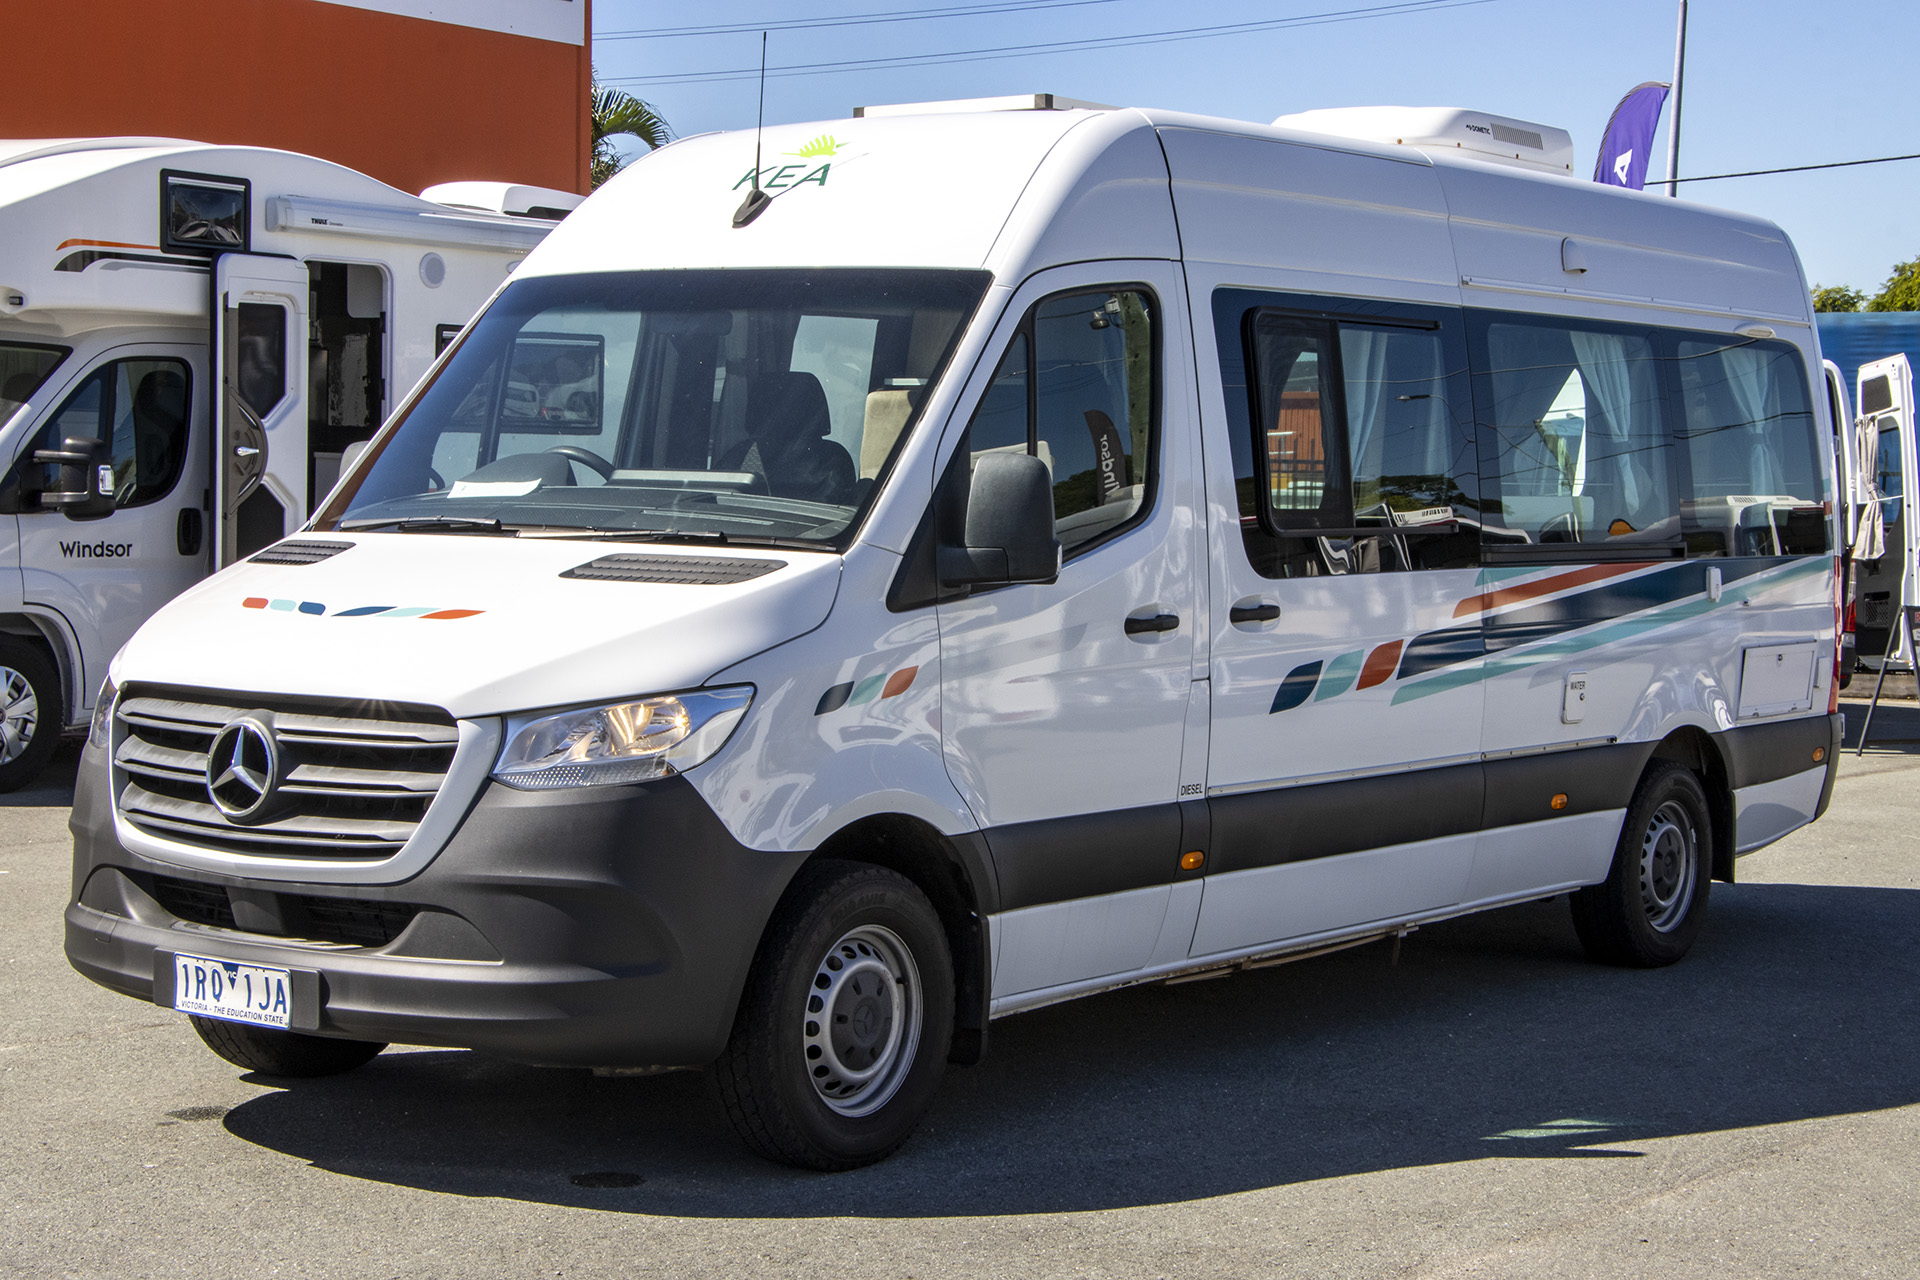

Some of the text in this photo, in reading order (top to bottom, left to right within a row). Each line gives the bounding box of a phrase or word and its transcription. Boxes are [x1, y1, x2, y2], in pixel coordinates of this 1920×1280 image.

[732, 163, 831, 191] KEA
[311, 217, 328, 226] THULE
[59, 541, 133, 558] Windsor
[1570, 681, 1585, 690] WATER
[1181, 783, 1203, 796] DIESEL
[181, 1000, 208, 1011] VICTORIA
[214, 1005, 225, 1015] THE
[227, 1007, 262, 1021] EDUCATION
[264, 1014, 284, 1025] STATE
